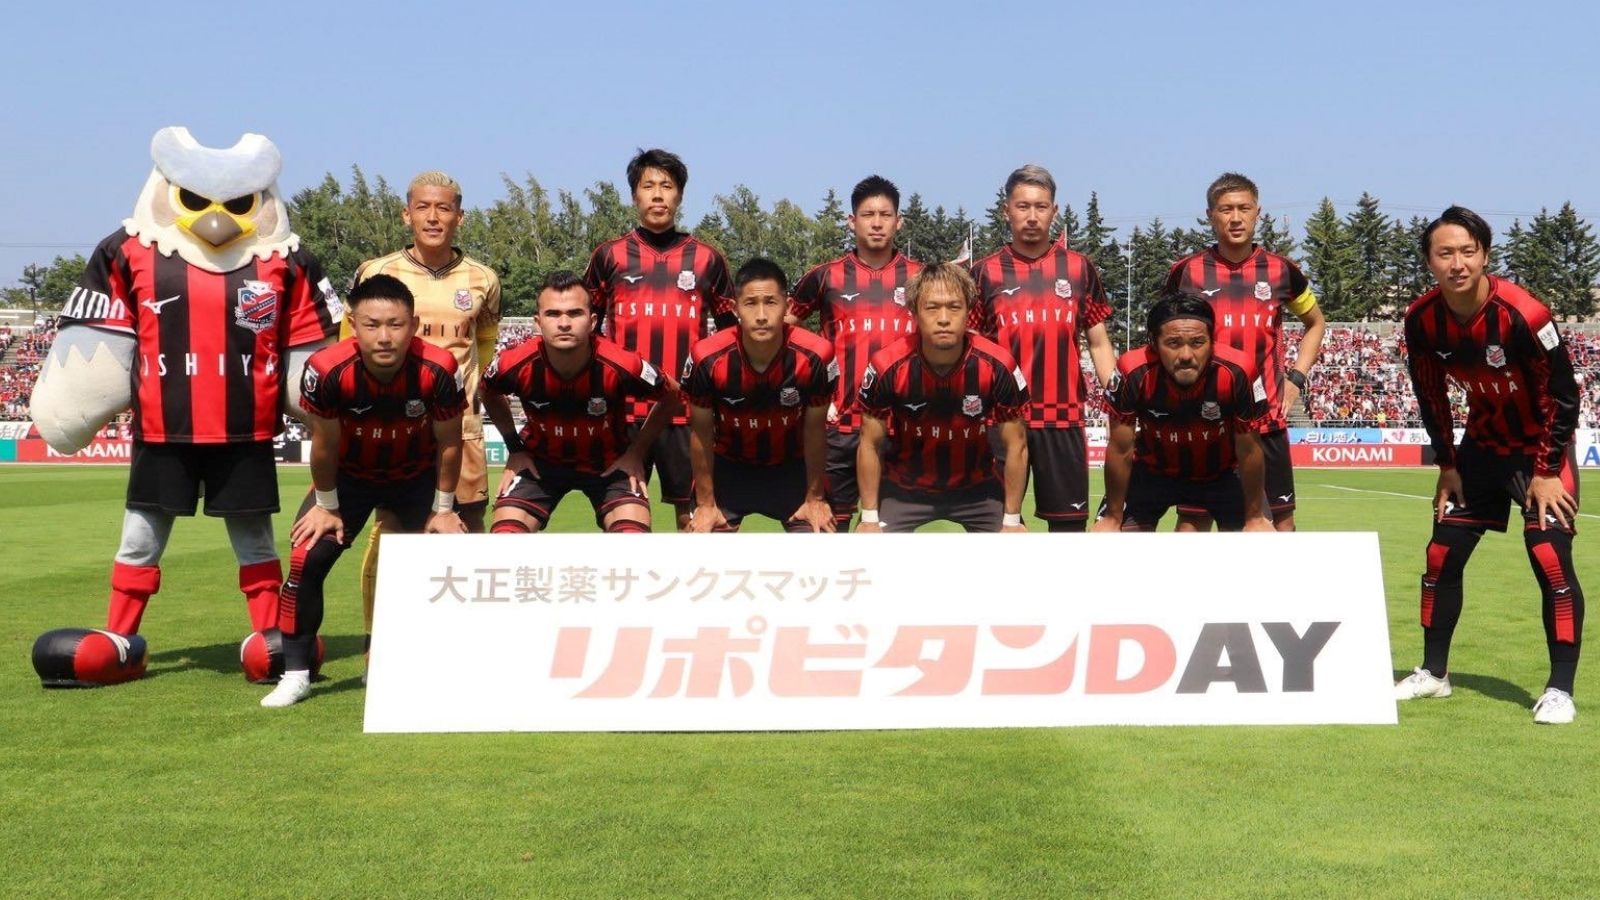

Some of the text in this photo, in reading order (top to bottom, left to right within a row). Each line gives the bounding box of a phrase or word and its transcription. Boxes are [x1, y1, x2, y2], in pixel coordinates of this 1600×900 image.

[618, 302, 697, 319] ISHIYA
[999, 308, 1073, 327] ISHIYA
[838, 318, 913, 333] ISHIYA
[1224, 313, 1273, 328] HIYA
[142, 352, 276, 376] ISHIYA
[47, 442, 131, 458] KNAMI
[1312, 447, 1393, 462] KONAMI
[428, 565, 873, 605] 大正製薬サンクスマッチ
